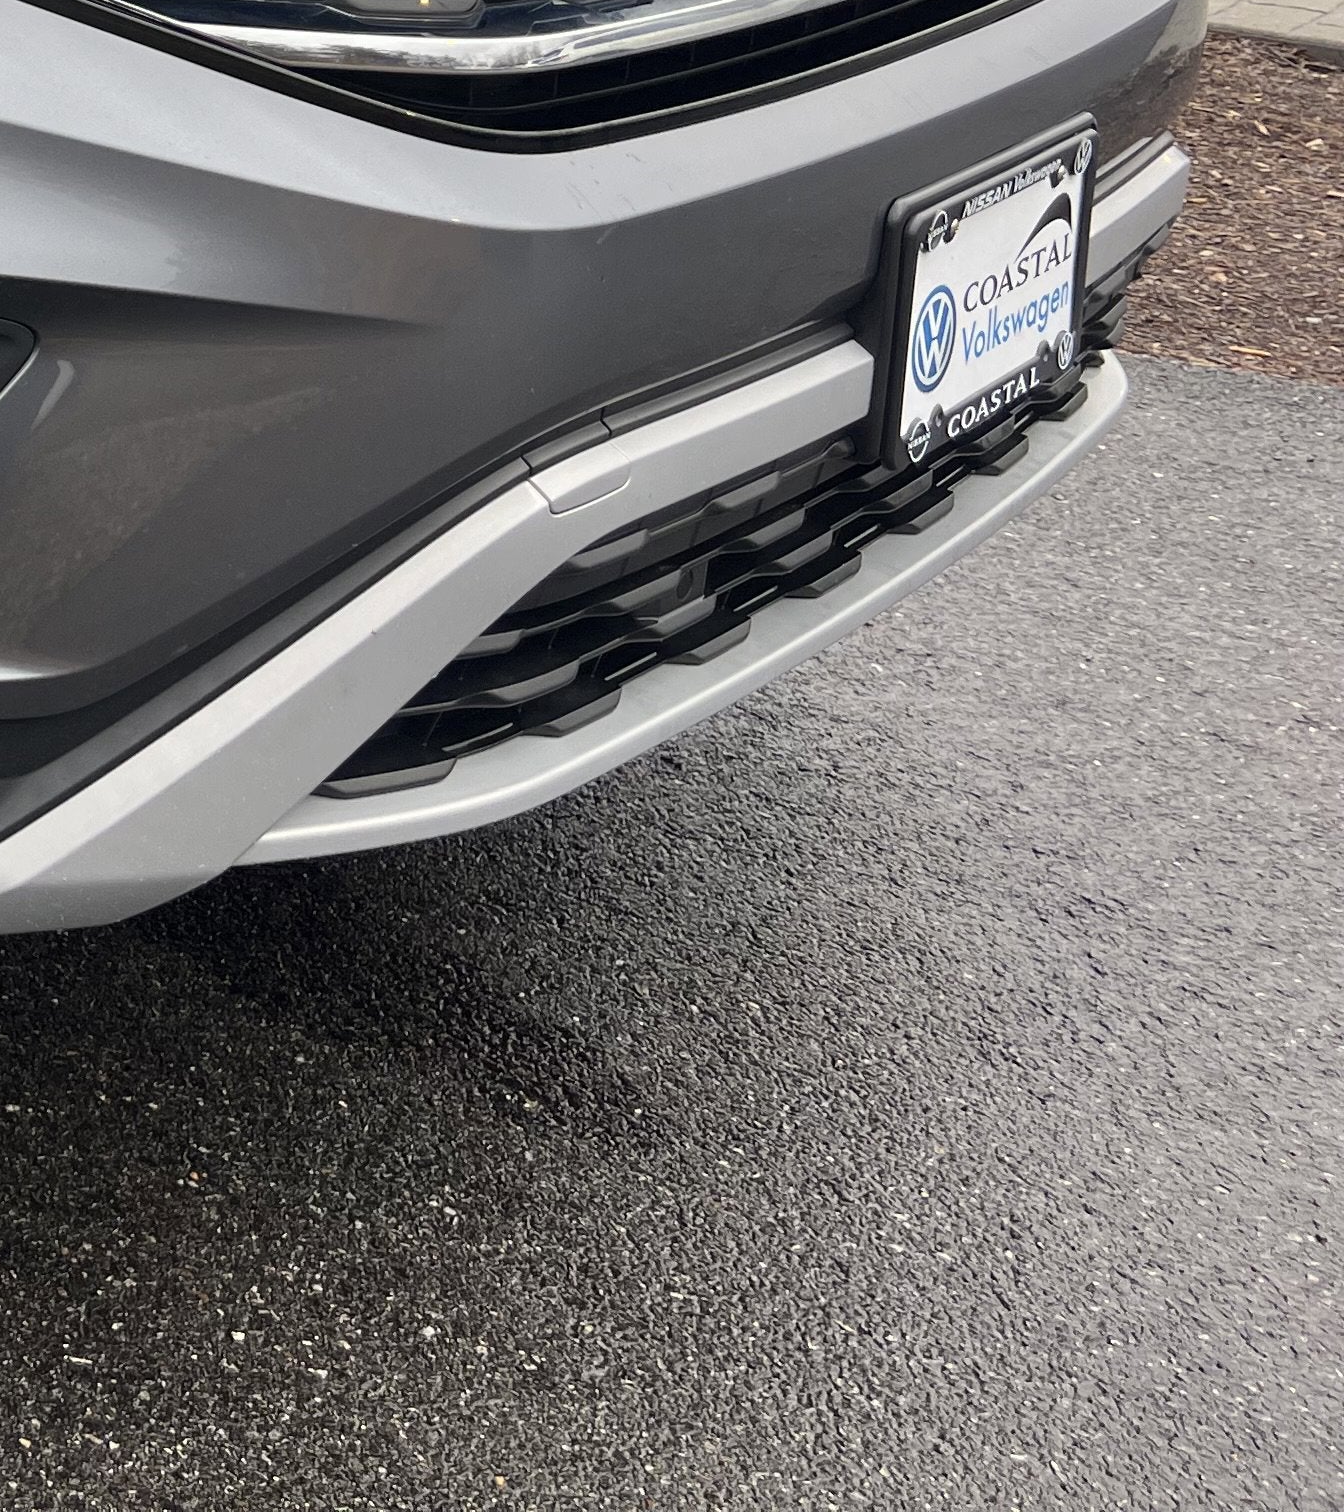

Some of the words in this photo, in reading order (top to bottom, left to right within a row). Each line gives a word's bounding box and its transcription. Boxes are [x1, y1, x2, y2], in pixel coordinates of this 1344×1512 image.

[962, 180, 1013, 219] NISSAN
[963, 232, 1073, 313] COASTAL
[963, 280, 1069, 366] Volkswagen
[947, 367, 1040, 438] COASTAL
